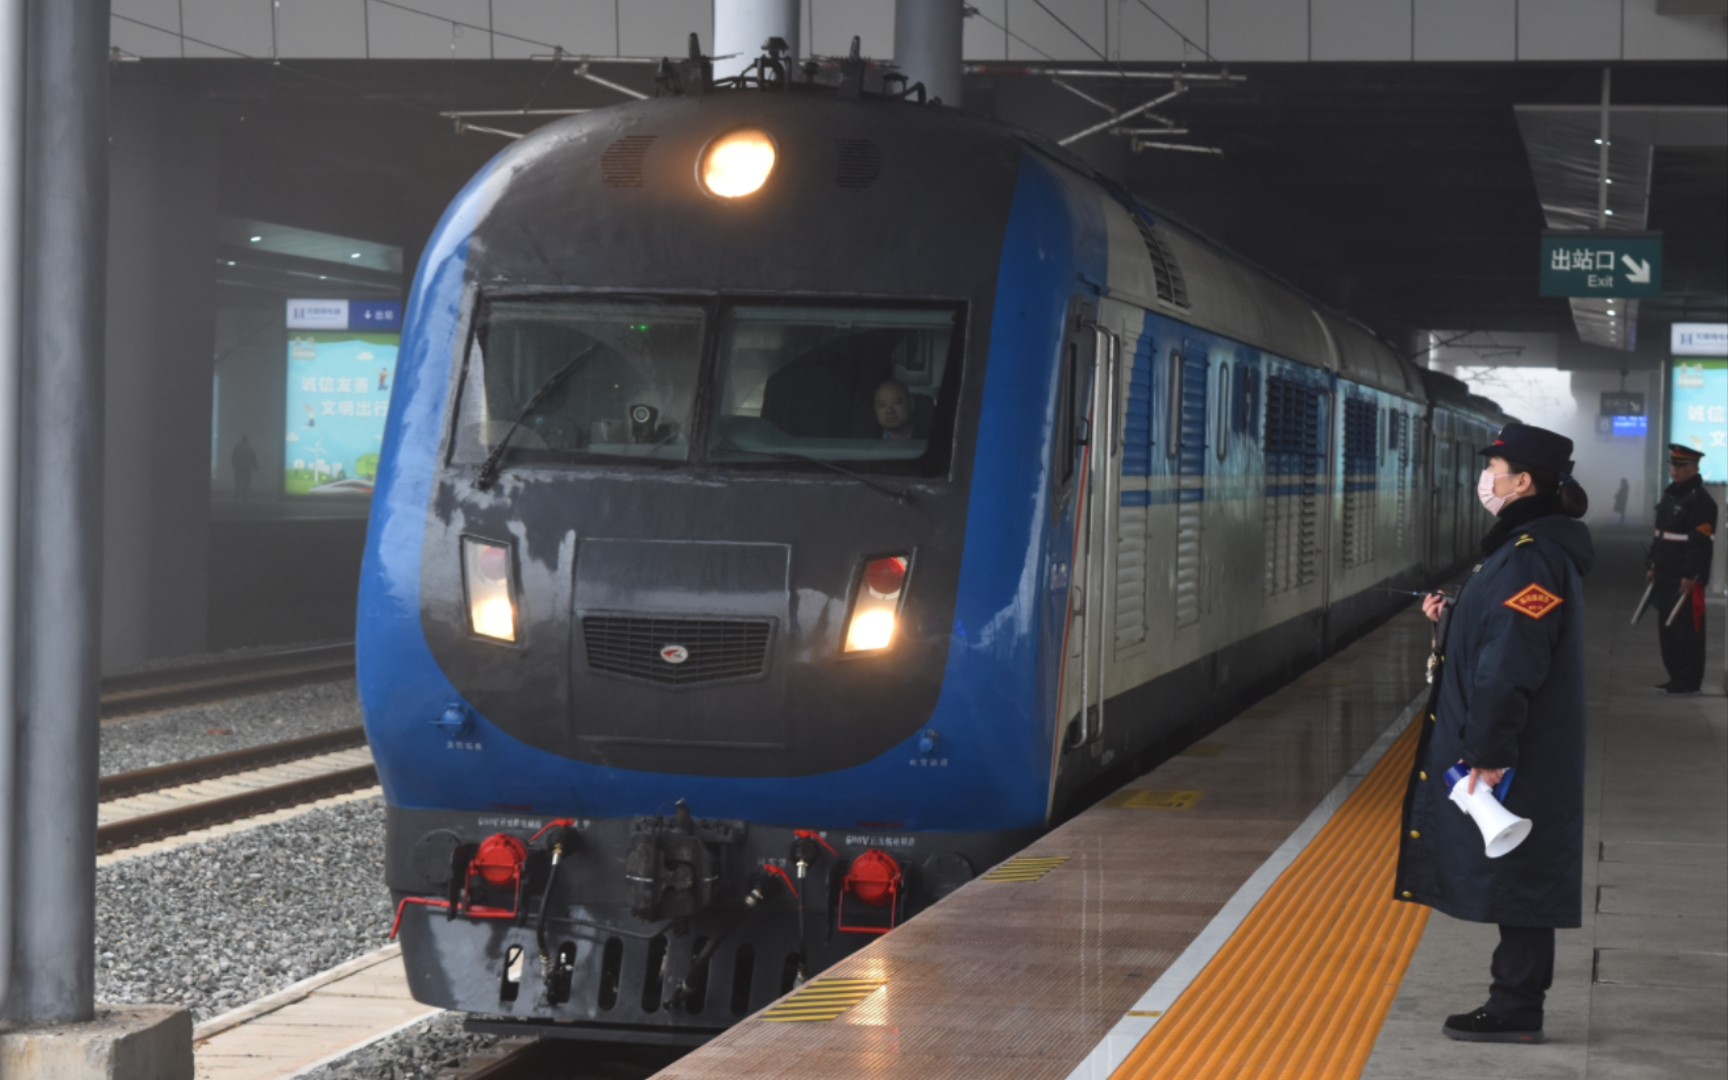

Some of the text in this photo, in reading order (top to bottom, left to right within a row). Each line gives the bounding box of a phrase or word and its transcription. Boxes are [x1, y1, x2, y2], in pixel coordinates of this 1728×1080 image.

[1551, 248, 1615, 271] 出站口
[1587, 274, 1614, 287] Exit
